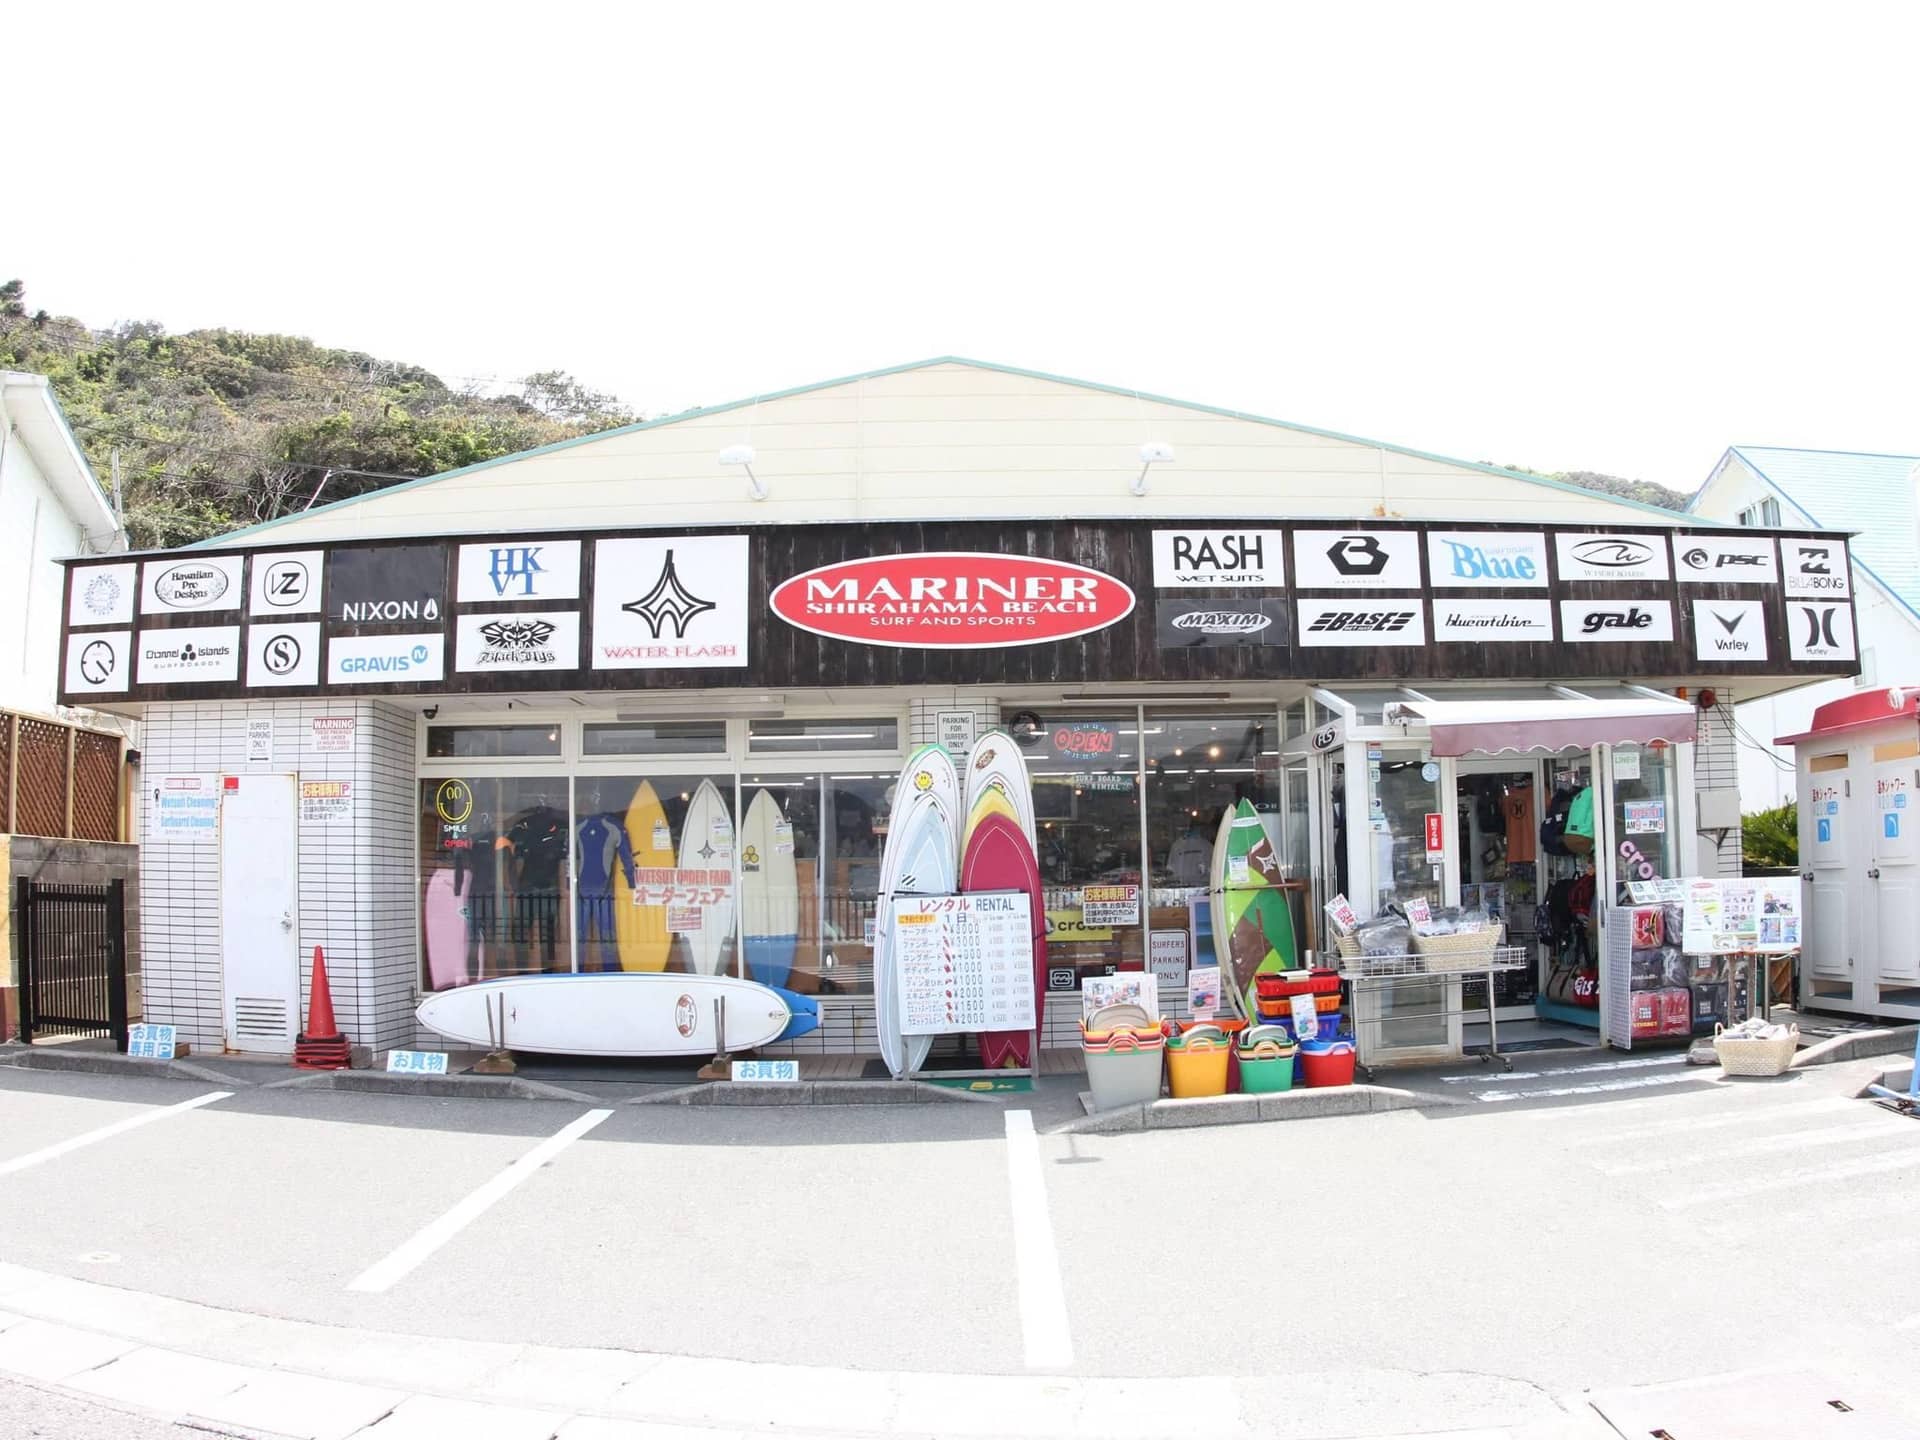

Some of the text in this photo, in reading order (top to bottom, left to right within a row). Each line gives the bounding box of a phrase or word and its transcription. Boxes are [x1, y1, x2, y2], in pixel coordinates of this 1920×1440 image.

[1173, 535, 1263, 570] RASH
[1441, 539, 1537, 580] Blue
[1715, 554, 1768, 567] psc
[172, 571, 213, 581] Hawaiian
[1220, 574, 1264, 582] SUITS
[1789, 576, 1844, 589] BILLABONG
[181, 581, 199, 590] Pro
[807, 577, 1098, 601] MARINER
[174, 589, 208, 600] Designs
[343, 601, 418, 622] NIXON
[807, 601, 1097, 614] SHIRAHAMA BEACH
[870, 616, 1036, 626] SURF AND SPORTS
[1181, 613, 1260, 627] MAXIM
[1583, 608, 1653, 633] gale
[604, 645, 737, 658] WATER FLASH
[1715, 640, 1749, 651] Varley
[340, 656, 409, 673] GRAVIS
[249, 722, 269, 730] SURFER
[314, 719, 354, 729] WARNING
[249, 731, 271, 739] PARKING
[1055, 728, 1113, 752] OPEN
[252, 740, 266, 748] ONLY
[443, 824, 467, 832] SMILE
[677, 869, 707, 885] ORDER
[709, 869, 731, 886] FAIR
[1128, 889, 1135, 898] P
[920, 898, 1015, 912] レンタル RENTAL
[1153, 941, 1185, 949] SURFERS
[1153, 956, 1185, 964] PARKING
[1158, 972, 1180, 980] ONLY
[133, 1025, 172, 1040] お買物
[393, 1053, 444, 1070] お買物
[741, 1062, 793, 1079] お買物
